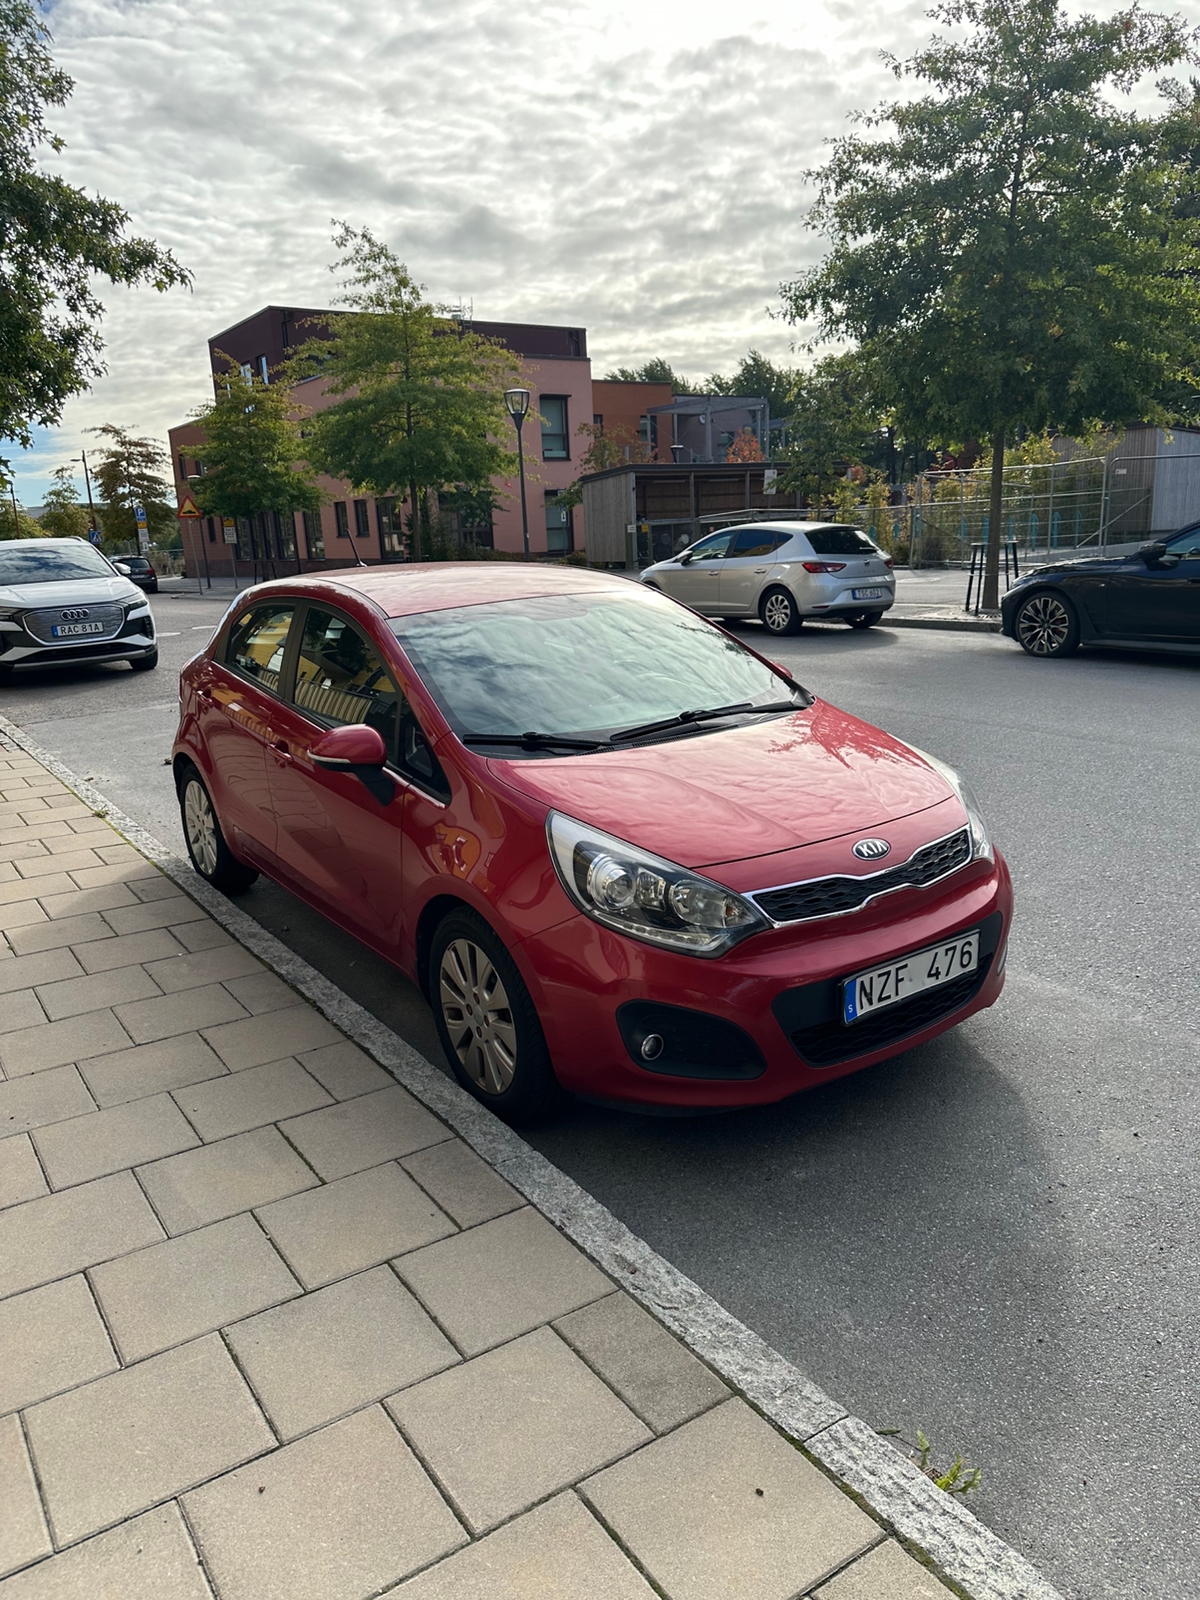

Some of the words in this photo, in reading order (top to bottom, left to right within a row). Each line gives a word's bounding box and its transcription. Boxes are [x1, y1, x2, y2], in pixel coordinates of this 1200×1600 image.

[60, 625, 79, 635] RAC
[81, 623, 100, 633] 81A
[857, 840, 888, 857] KIA
[860, 963, 908, 1010] NZF
[927, 941, 973, 980] 476
[848, 1004, 854, 1014] S
